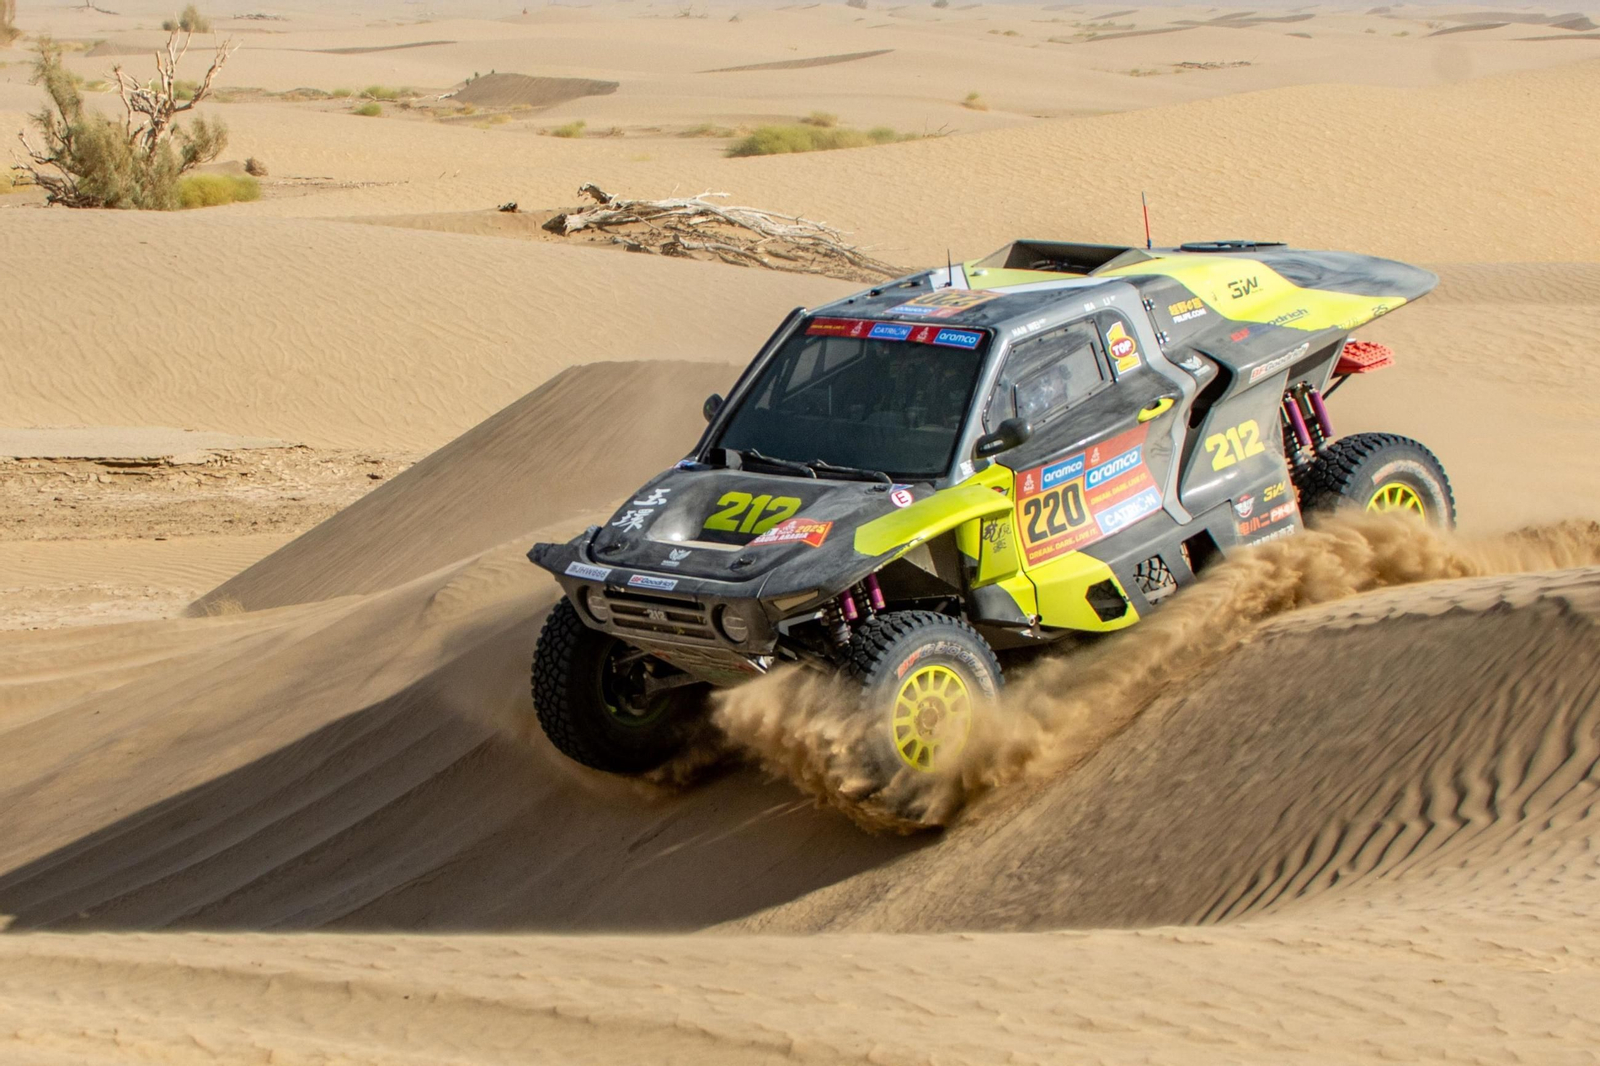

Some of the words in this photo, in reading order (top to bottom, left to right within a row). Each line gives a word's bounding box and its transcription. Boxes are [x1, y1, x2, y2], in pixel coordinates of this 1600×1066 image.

[939, 332, 977, 344] aramco
[1113, 340, 1131, 355] TOP
[1204, 419, 1265, 472] 212
[1044, 461, 1083, 482] aramco
[1089, 451, 1138, 484] aramco
[896, 491, 909, 504] E
[703, 491, 802, 535] 212
[1024, 483, 1086, 544] 220
[1104, 493, 1157, 527] CATRION
[795, 524, 827, 534] 2025
[631, 576, 675, 588] BFGoodrich
